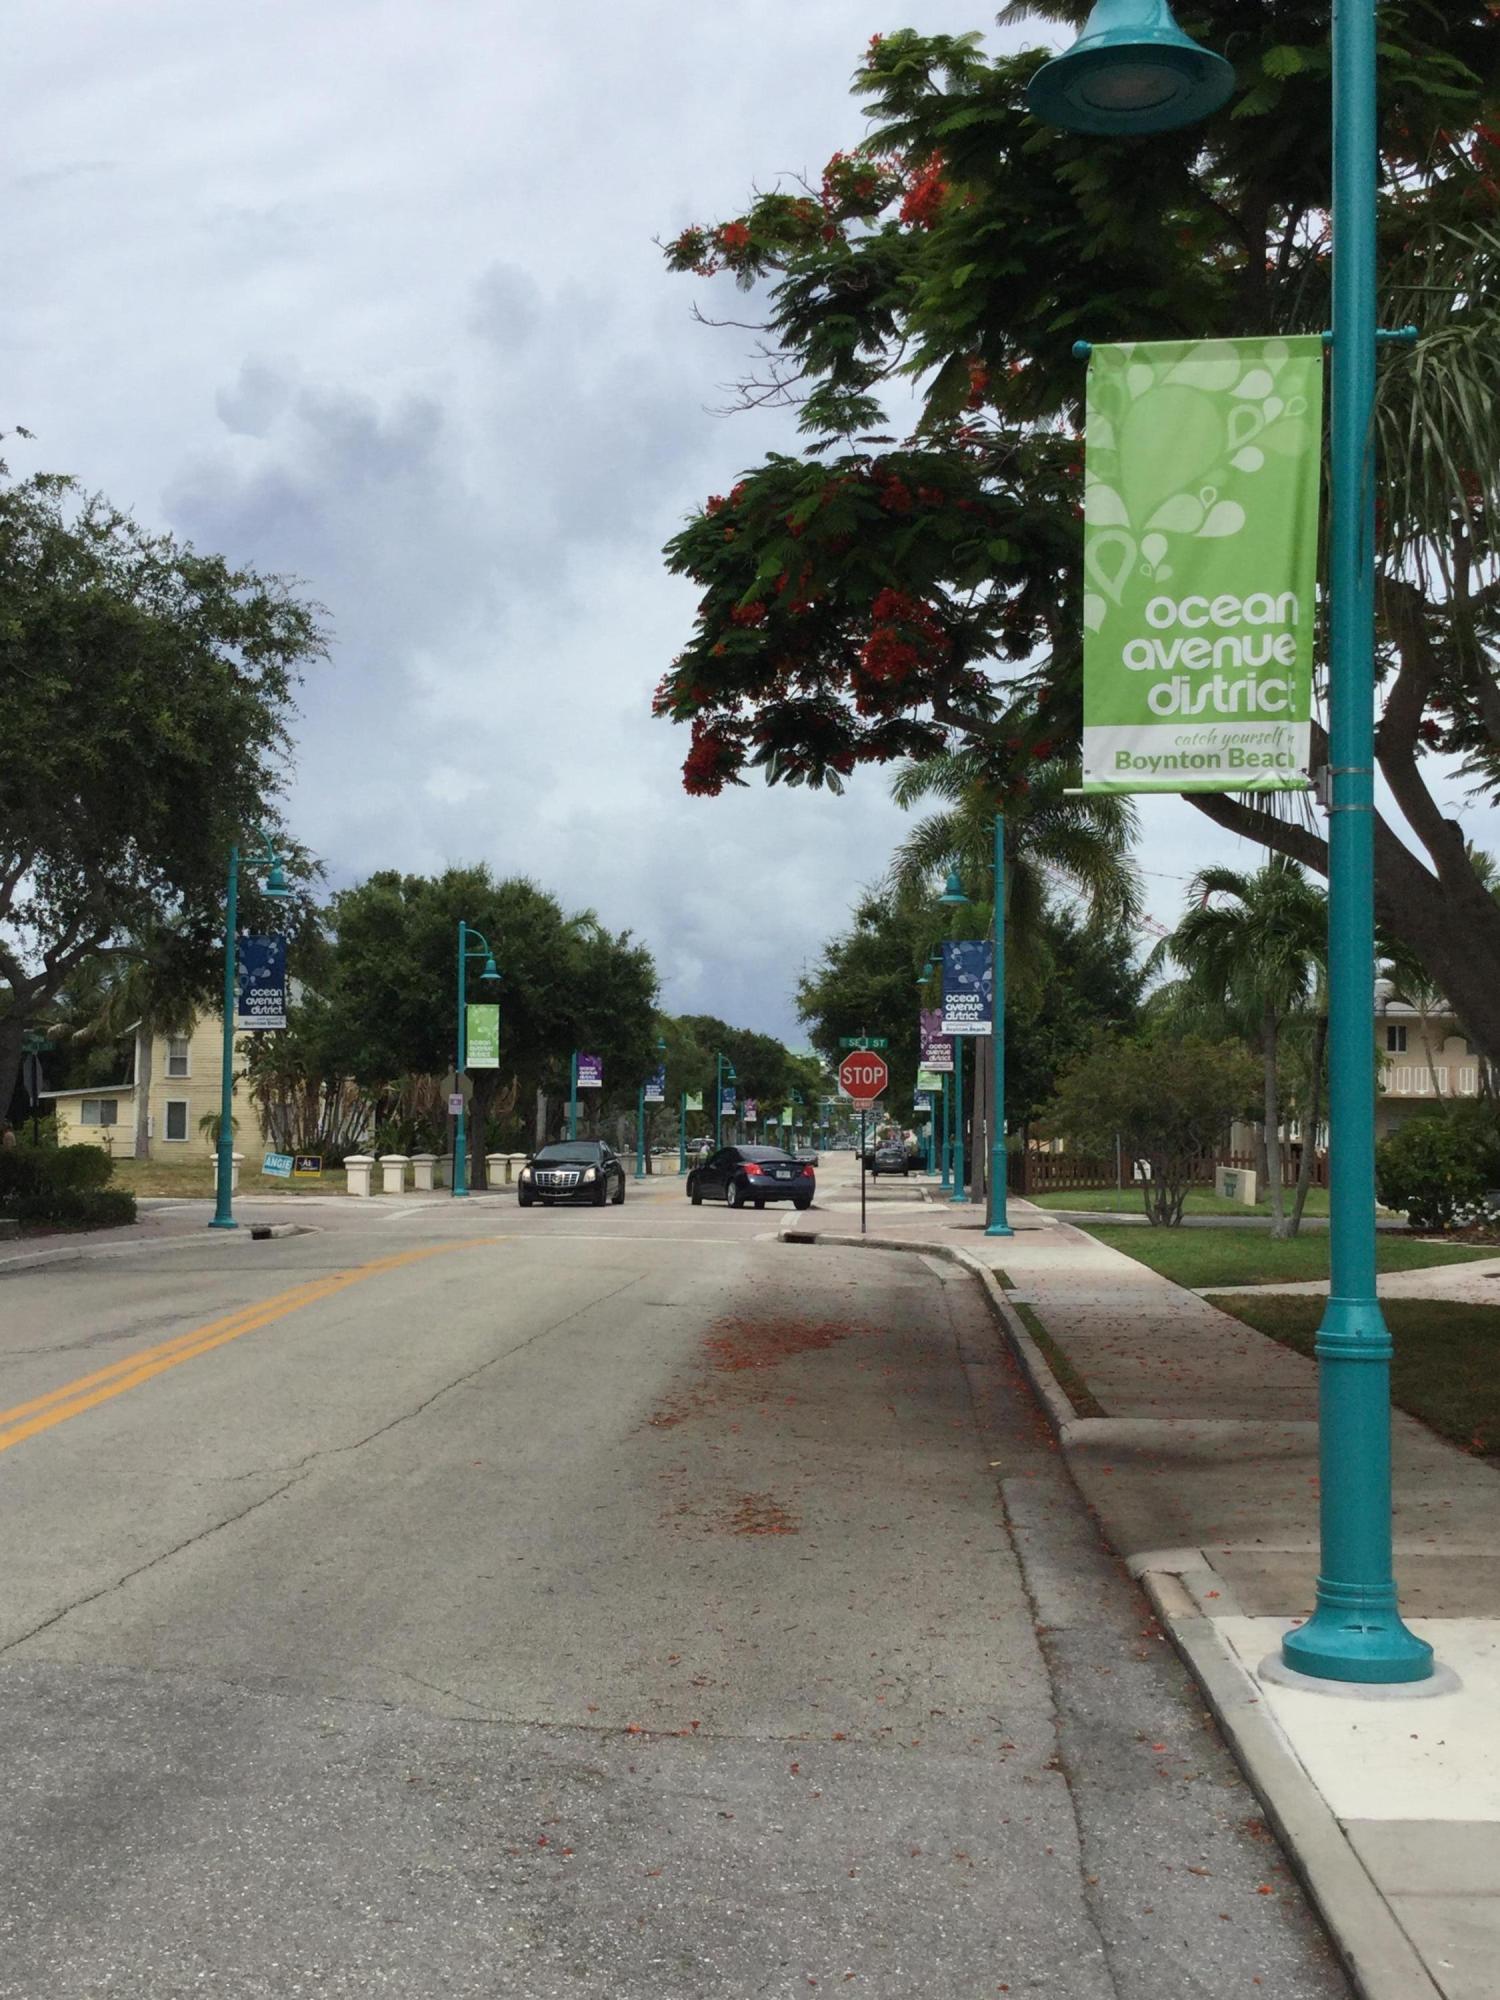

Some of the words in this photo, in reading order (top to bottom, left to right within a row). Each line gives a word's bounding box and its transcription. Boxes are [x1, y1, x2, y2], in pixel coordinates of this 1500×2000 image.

[1145, 592, 1299, 629] ocean
[1122, 633, 1296, 671] avenue
[1174, 728, 1217, 746] catch
[1220, 726, 1284, 750] yourself
[1115, 750, 1221, 773] Boynton
[250, 988, 283, 997] ocean
[945, 994, 980, 1003] ocean
[245, 997, 283, 1005] avenue
[945, 1003, 985, 1011] avenue
[250, 1005, 283, 1015] district
[945, 1011, 980, 1021] district
[842, 1066, 884, 1085] STOP
[265, 1156, 292, 1170] ANGIE
